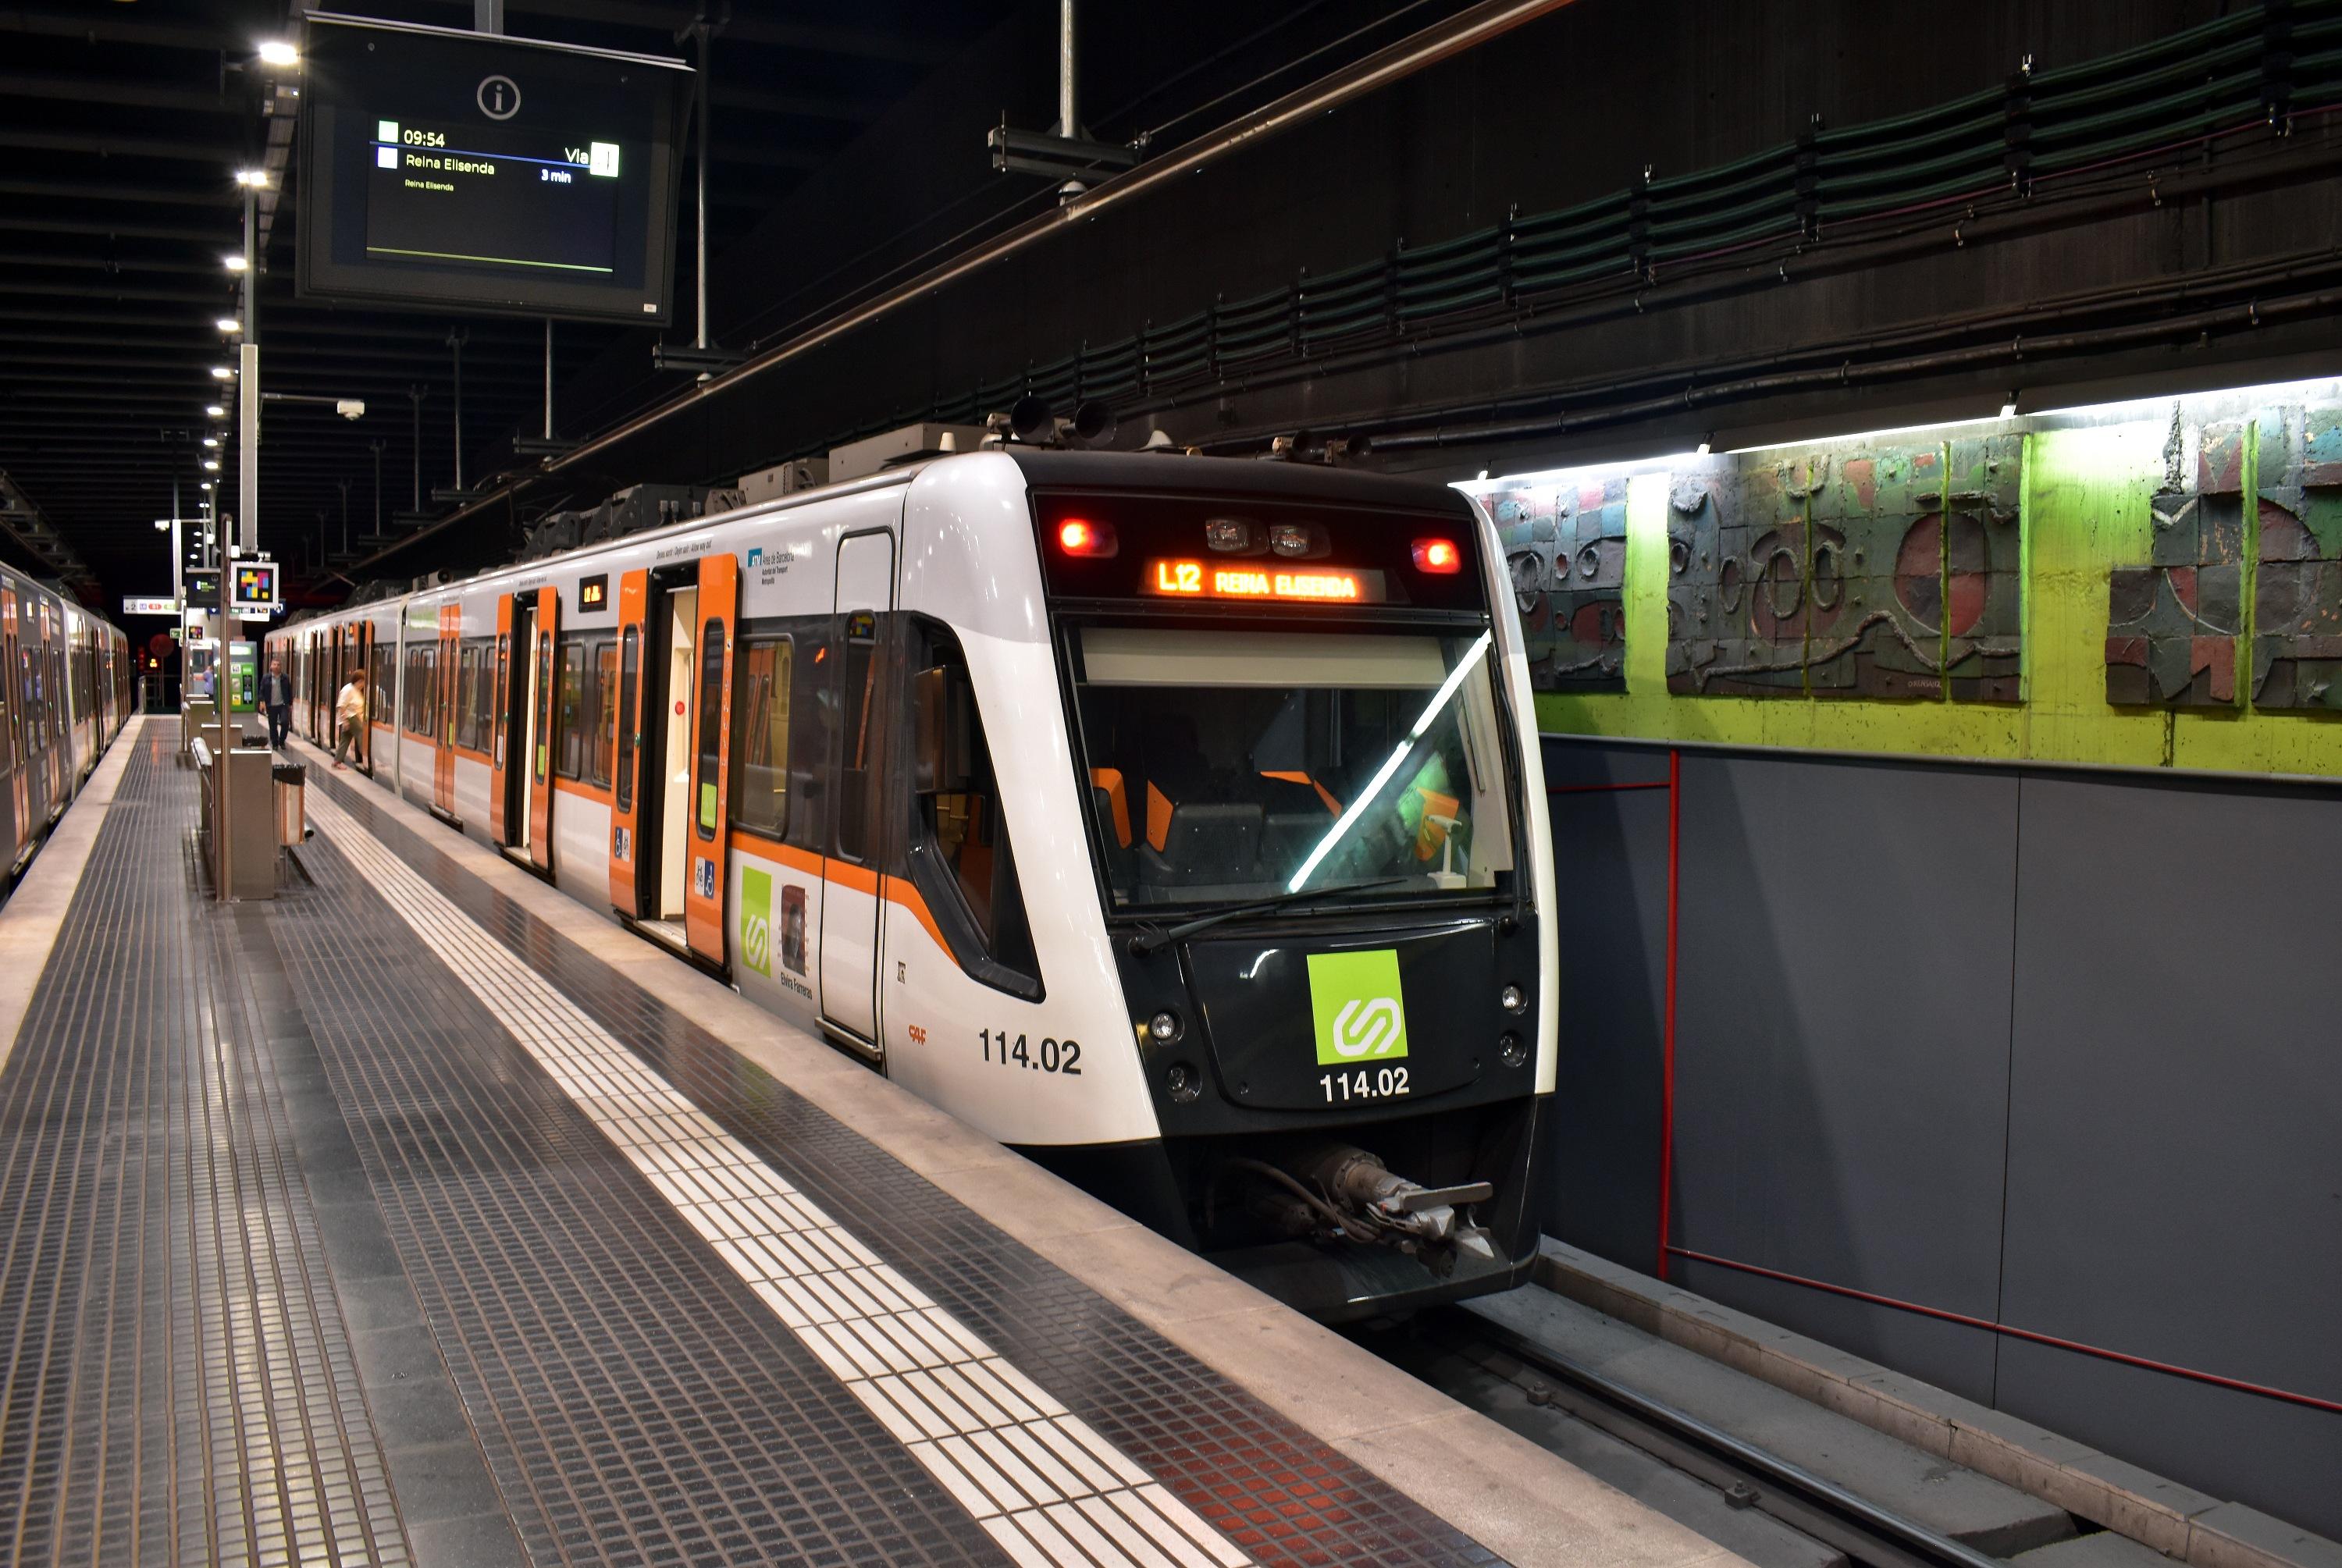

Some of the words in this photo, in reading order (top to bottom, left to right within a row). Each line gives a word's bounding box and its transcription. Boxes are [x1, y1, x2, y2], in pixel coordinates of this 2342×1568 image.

[404, 130, 445, 148] 09:54
[406, 155, 440, 169] Reina
[444, 158, 495, 175] Elisenda
[565, 147, 589, 164] Via
[405, 179, 424, 188] Reina
[425, 181, 454, 191] Elisenda
[550, 170, 571, 183] min
[777, 550, 794, 564] Barcelona
[1159, 563, 1201, 592] L12
[1215, 572, 1269, 594] REINA
[1275, 574, 1356, 598] ELISENDA
[781, 972, 793, 990] Elvira
[794, 978, 813, 1000] Farreras
[980, 1029, 1081, 1075] 114.02
[1320, 1067, 1410, 1102] 114.02
